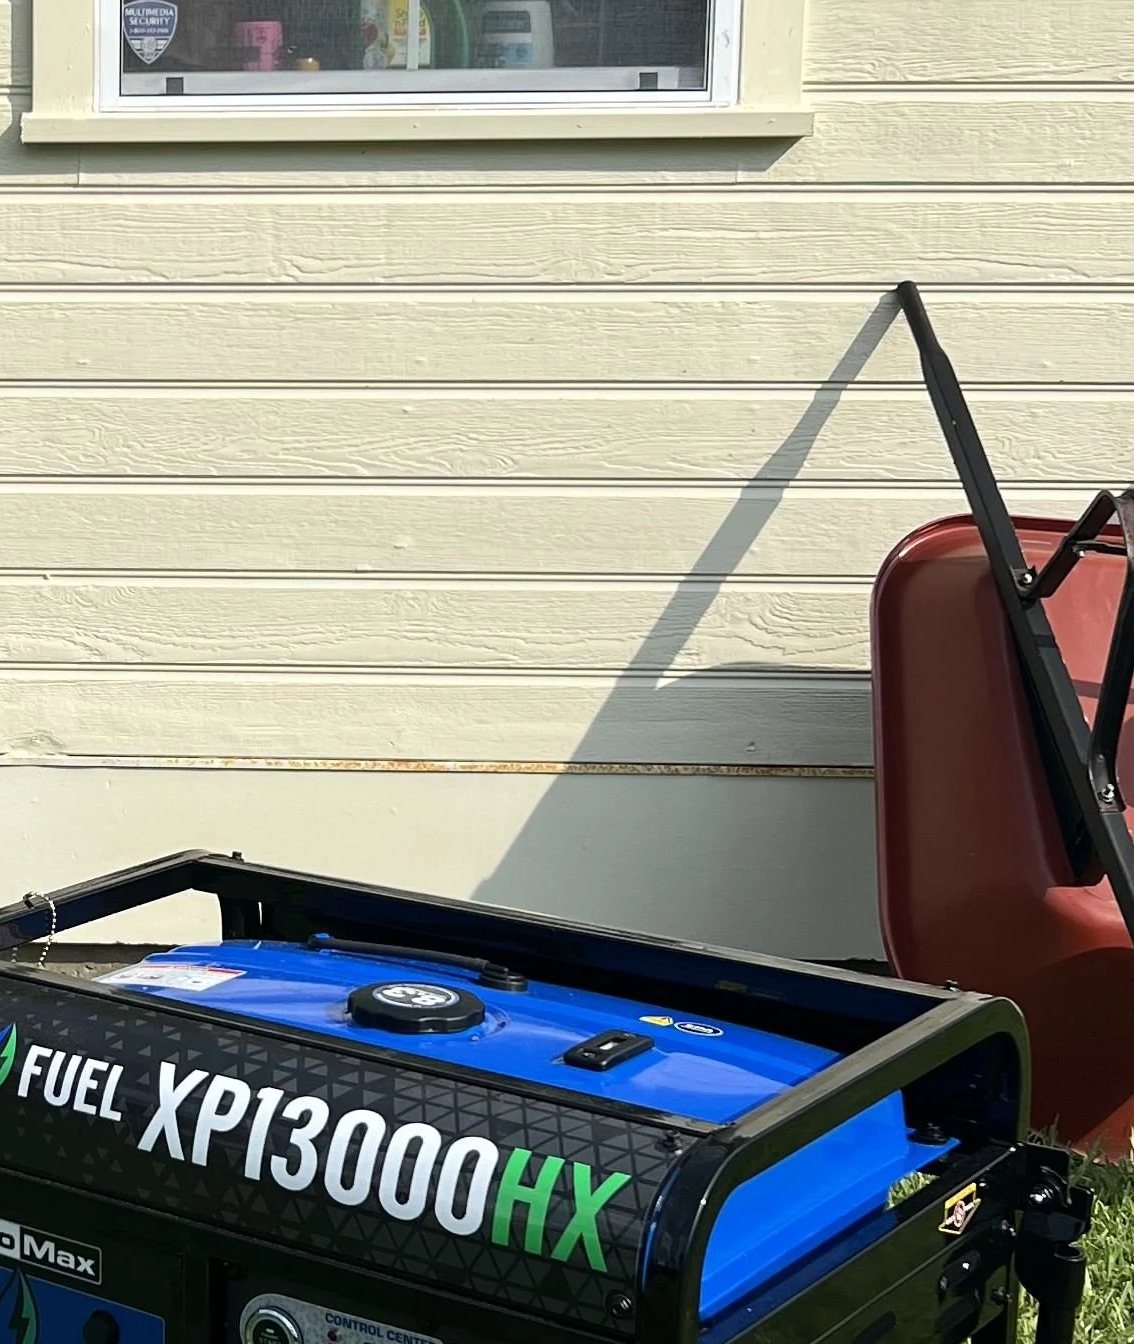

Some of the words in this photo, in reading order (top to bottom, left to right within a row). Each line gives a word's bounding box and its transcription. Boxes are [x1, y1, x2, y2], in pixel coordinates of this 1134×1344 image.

[125, 8, 174, 17] MULTIMEDIA
[129, 16, 170, 26] SECURITY
[18, 1045, 124, 1122] FUEL
[138, 1061, 631, 1273] XP13000HX
[325, 1313, 384, 1338] CONTROL
